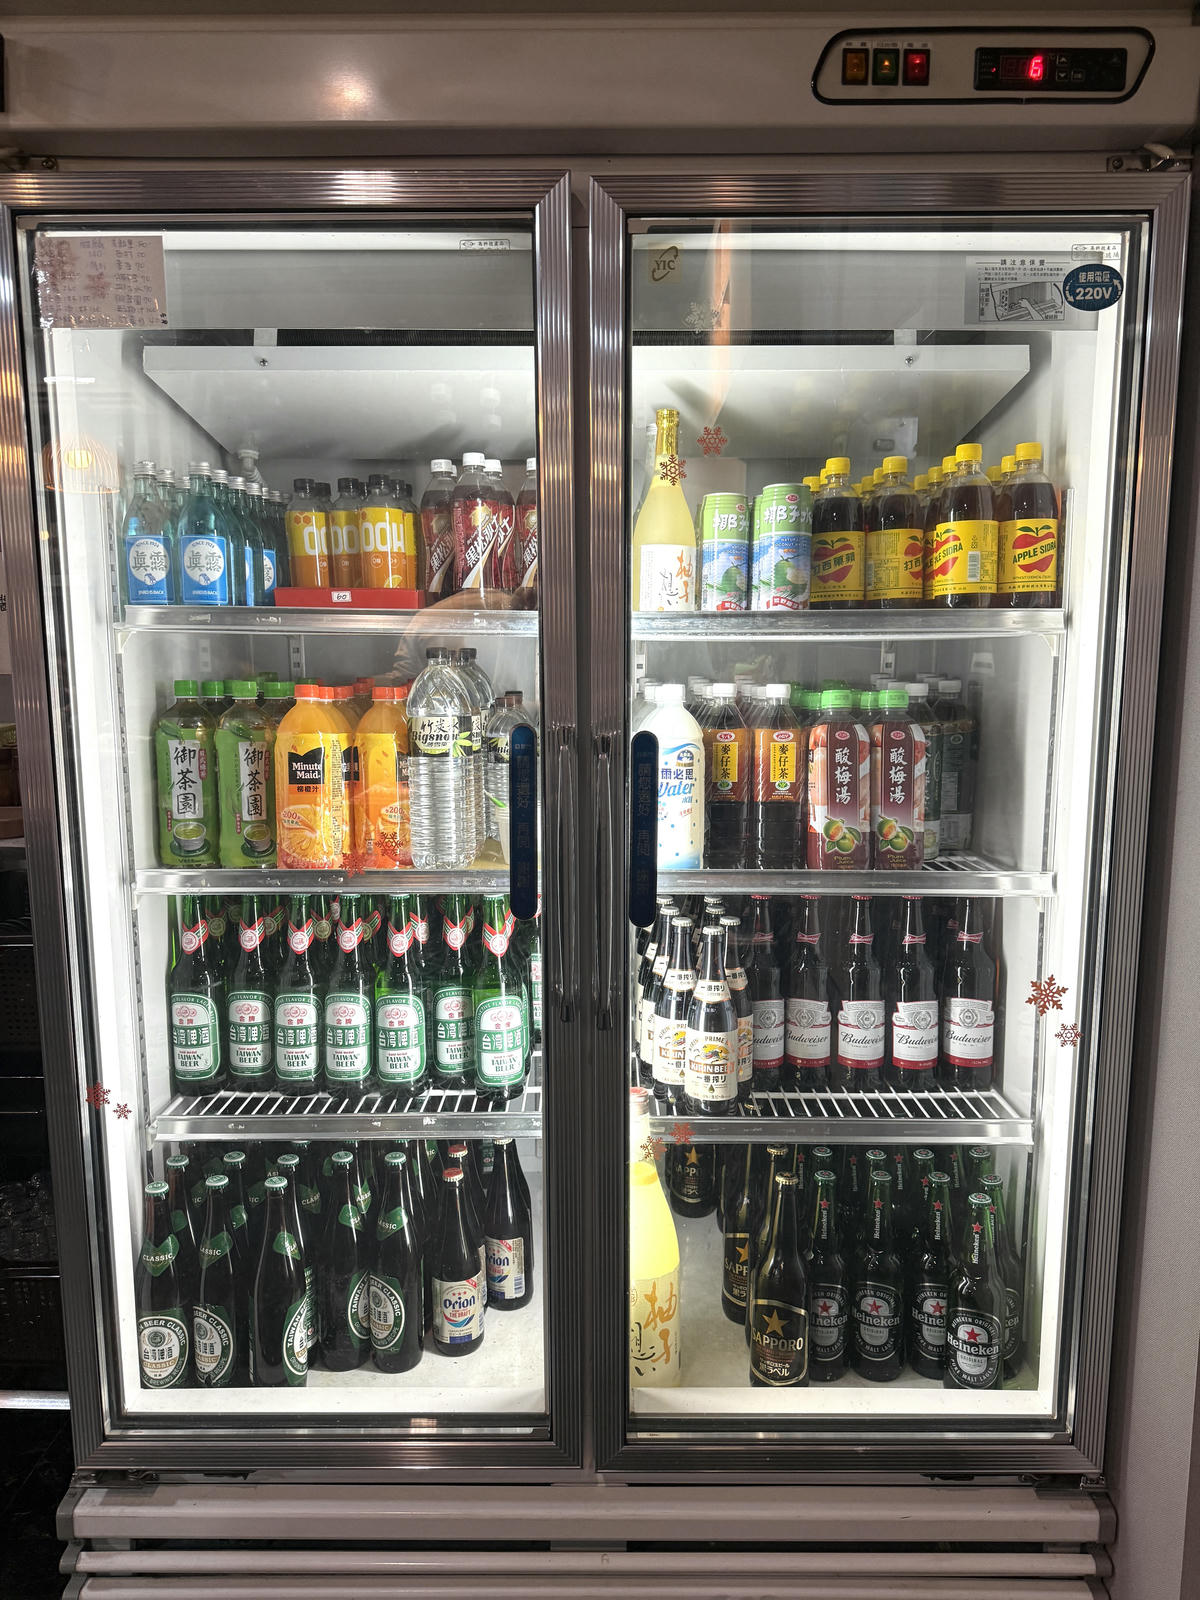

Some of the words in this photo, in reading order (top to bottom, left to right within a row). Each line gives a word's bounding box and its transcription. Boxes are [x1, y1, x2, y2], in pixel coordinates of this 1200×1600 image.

[1029, 56, 1043, 80] 6
[655, 259, 675, 270] YIC
[1075, 287, 1112, 300] 220V
[764, 504, 812, 524] 椰子水
[942, 542, 963, 558] SIDRA
[1012, 547, 1038, 564] APPLE
[292, 762, 322, 771] Minute
[720, 744, 731, 779] 麥仔茶
[778, 744, 789, 780] 麥仔茶
[173, 747, 197, 815] 御茶園
[243, 747, 263, 817] 御茶園
[296, 770, 318, 779] Maid
[661, 768, 694, 780] 雨必思
[834, 747, 853, 805] 酸梅湯
[889, 747, 908, 805] 酸梅湯
[700, 983, 725, 992] 一番搾り
[945, 1029, 991, 1044] Budweiser
[177, 1053, 202, 1061] TAIWAN
[386, 1055, 411, 1063] TAIWAN
[690, 1059, 713, 1073] KIRIN
[696, 1075, 727, 1084] 一番搾り
[142, 1253, 173, 1262] CLASSIC
[972, 1233, 980, 1264] Heineken
[486, 1253, 509, 1266] rion
[351, 1282, 365, 1313] TAIWAN
[382, 1286, 401, 1317] CLASSIC
[443, 1295, 475, 1309] Orion
[167, 1322, 186, 1346] CLASSIC
[208, 1315, 230, 1346] CLASSIC
[287, 1313, 302, 1348] TAIWAN
[952, 1316, 973, 1329] HEINEKEN
[974, 1318, 996, 1337] ORIGINAL
[752, 1327, 804, 1351] SAPPORO
[865, 1345, 879, 1353] MALT
[881, 1337, 894, 1352] LAGER
[947, 1332, 999, 1355] Heineken
[143, 1360, 175, 1368] CLASSIC
[950, 1358, 961, 1374] PURE
[962, 1373, 977, 1382] MALT
[979, 1366, 994, 1381] LAGER
